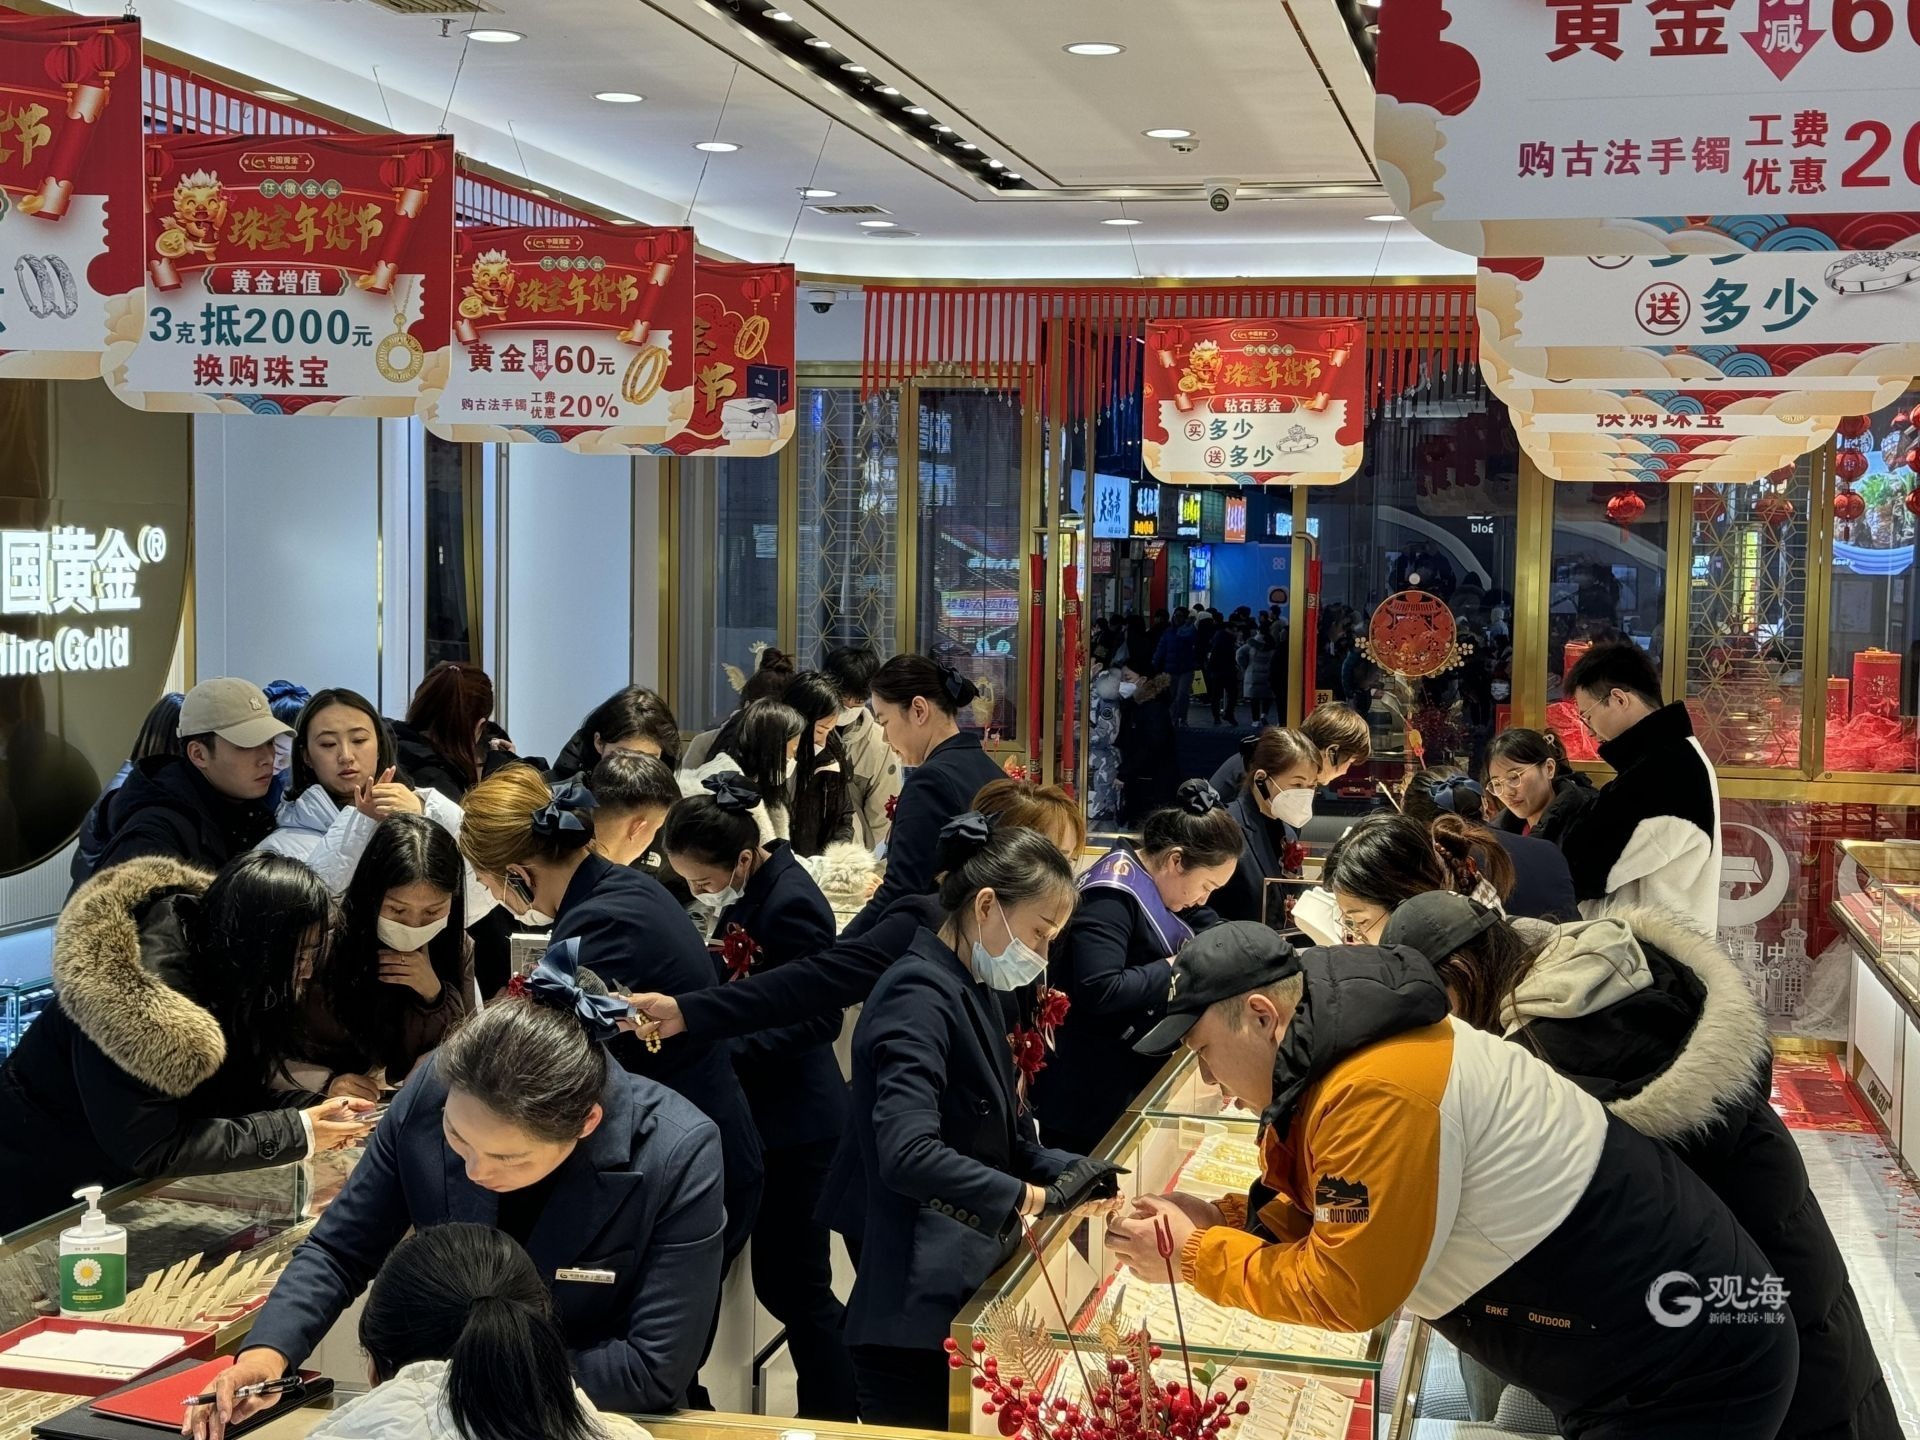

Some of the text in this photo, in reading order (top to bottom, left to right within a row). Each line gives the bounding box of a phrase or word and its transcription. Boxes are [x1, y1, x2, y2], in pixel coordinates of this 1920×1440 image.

[1745, 109, 1829, 148] 工费
[1518, 136, 1730, 178] 购古法手镯
[1743, 156, 1827, 195] 优惠
[227, 202, 383, 255] 珠宝年货节
[231, 270, 321, 294] 黄金增值
[515, 273, 639, 316] 珠宝年货节
[149, 303, 373, 347] 3克抵2000元
[194, 354, 328, 388] 换购珠宝
[468, 343, 526, 373] 黄金
[554, 345, 616, 376] 60元
[461, 391, 619, 419] 购古法手镯 工费 优惠 20%
[1224, 398, 1282, 413] 钻石彩金
[56, 626, 129, 671] Gold
[1485, 1304, 1571, 1328] ERKE OUTDOOR
